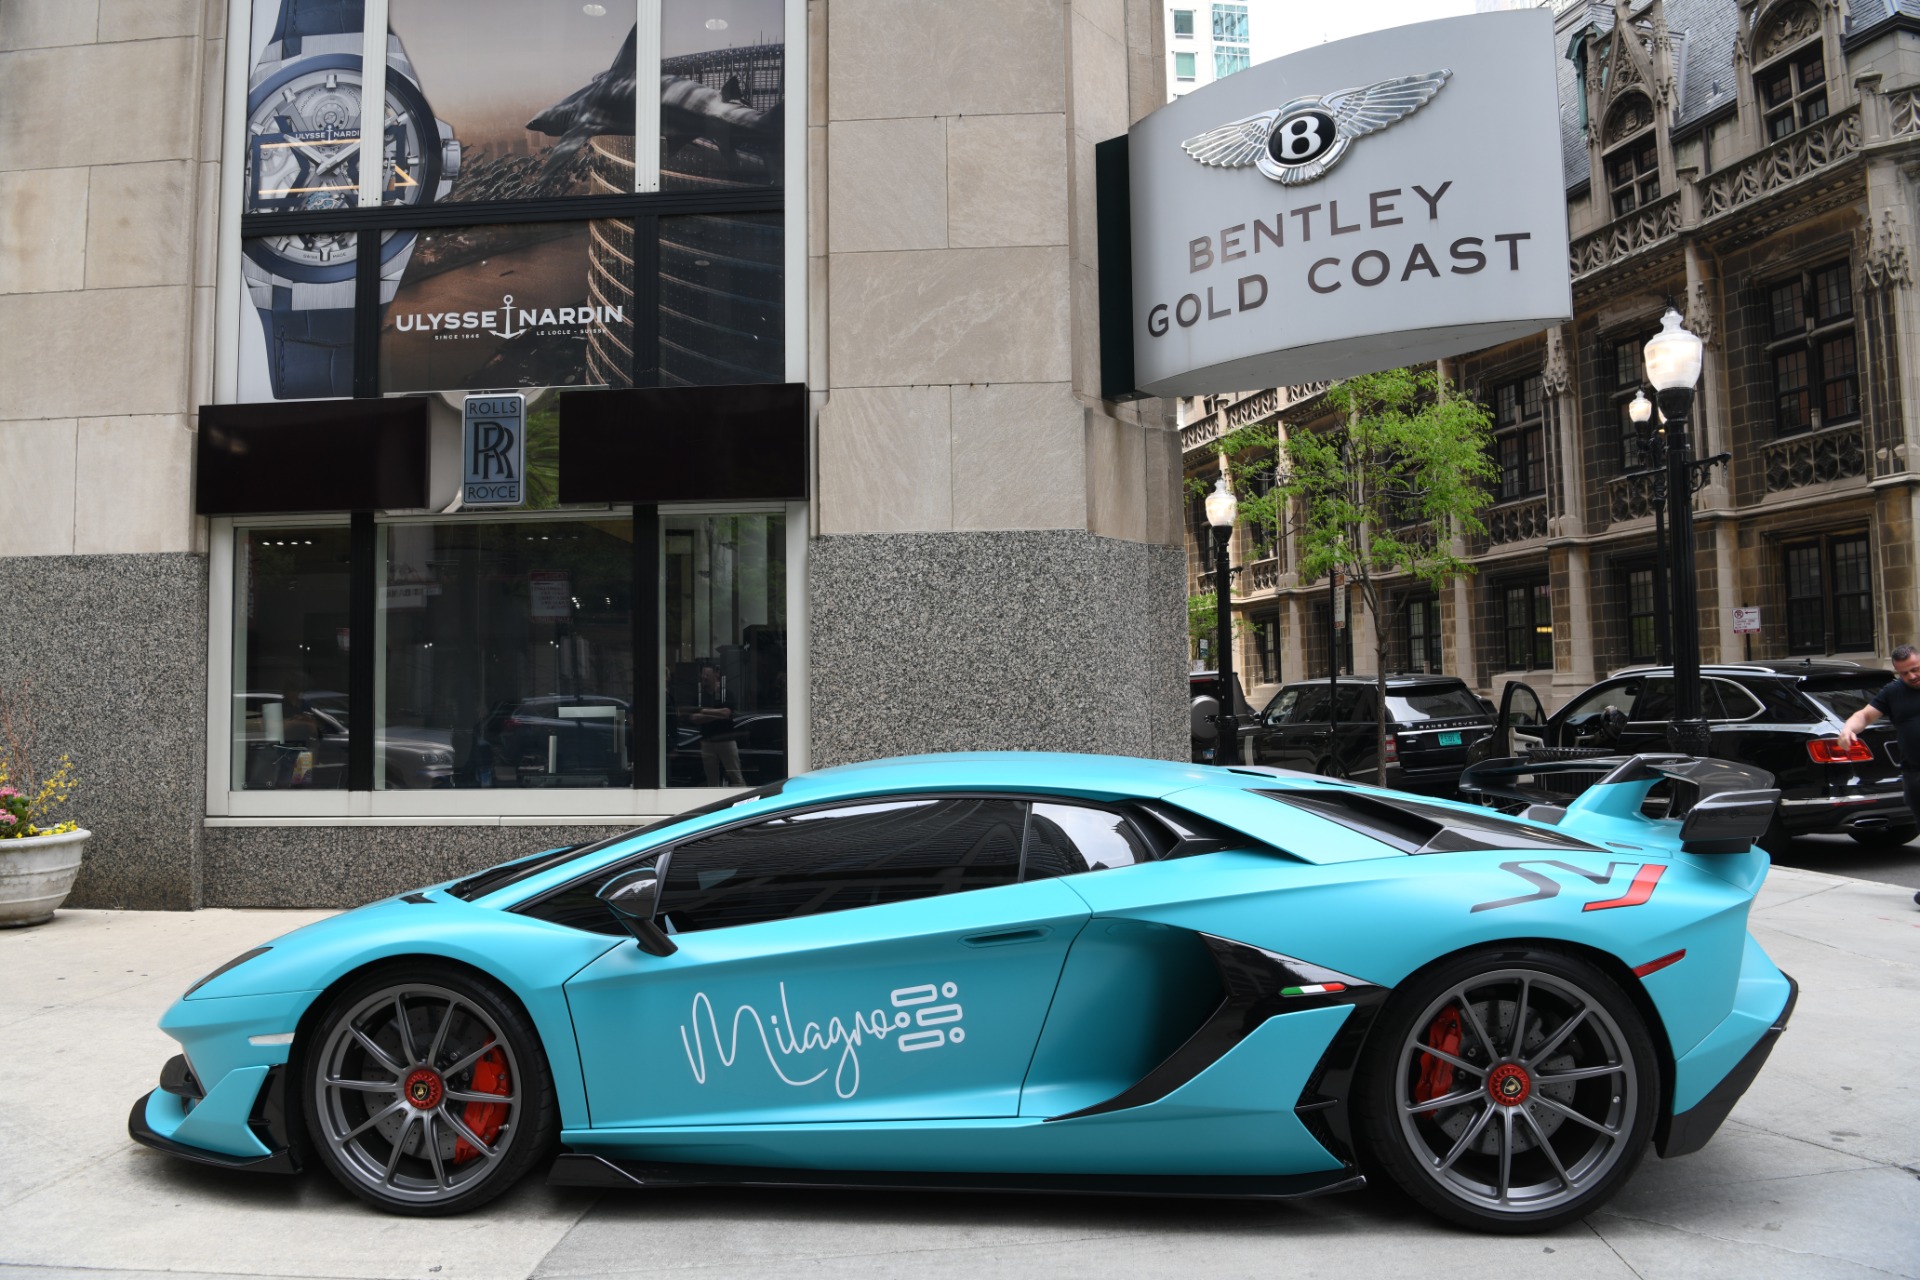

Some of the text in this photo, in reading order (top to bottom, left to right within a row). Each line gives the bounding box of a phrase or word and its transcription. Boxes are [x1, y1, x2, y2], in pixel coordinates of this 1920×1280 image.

[333, 130, 360, 138] NARDI
[1279, 115, 1322, 159] B
[1189, 180, 1454, 274] BENTLEY
[1147, 232, 1532, 338] GOLD COAST
[395, 305, 623, 332] ULYSSE NARDIN
[469, 401, 517, 415] ROLLS
[472, 421, 514, 479] RR
[468, 486, 516, 499] ROYCE
[1470, 859, 1669, 913] SVJ
[680, 981, 898, 1099] Milagro
